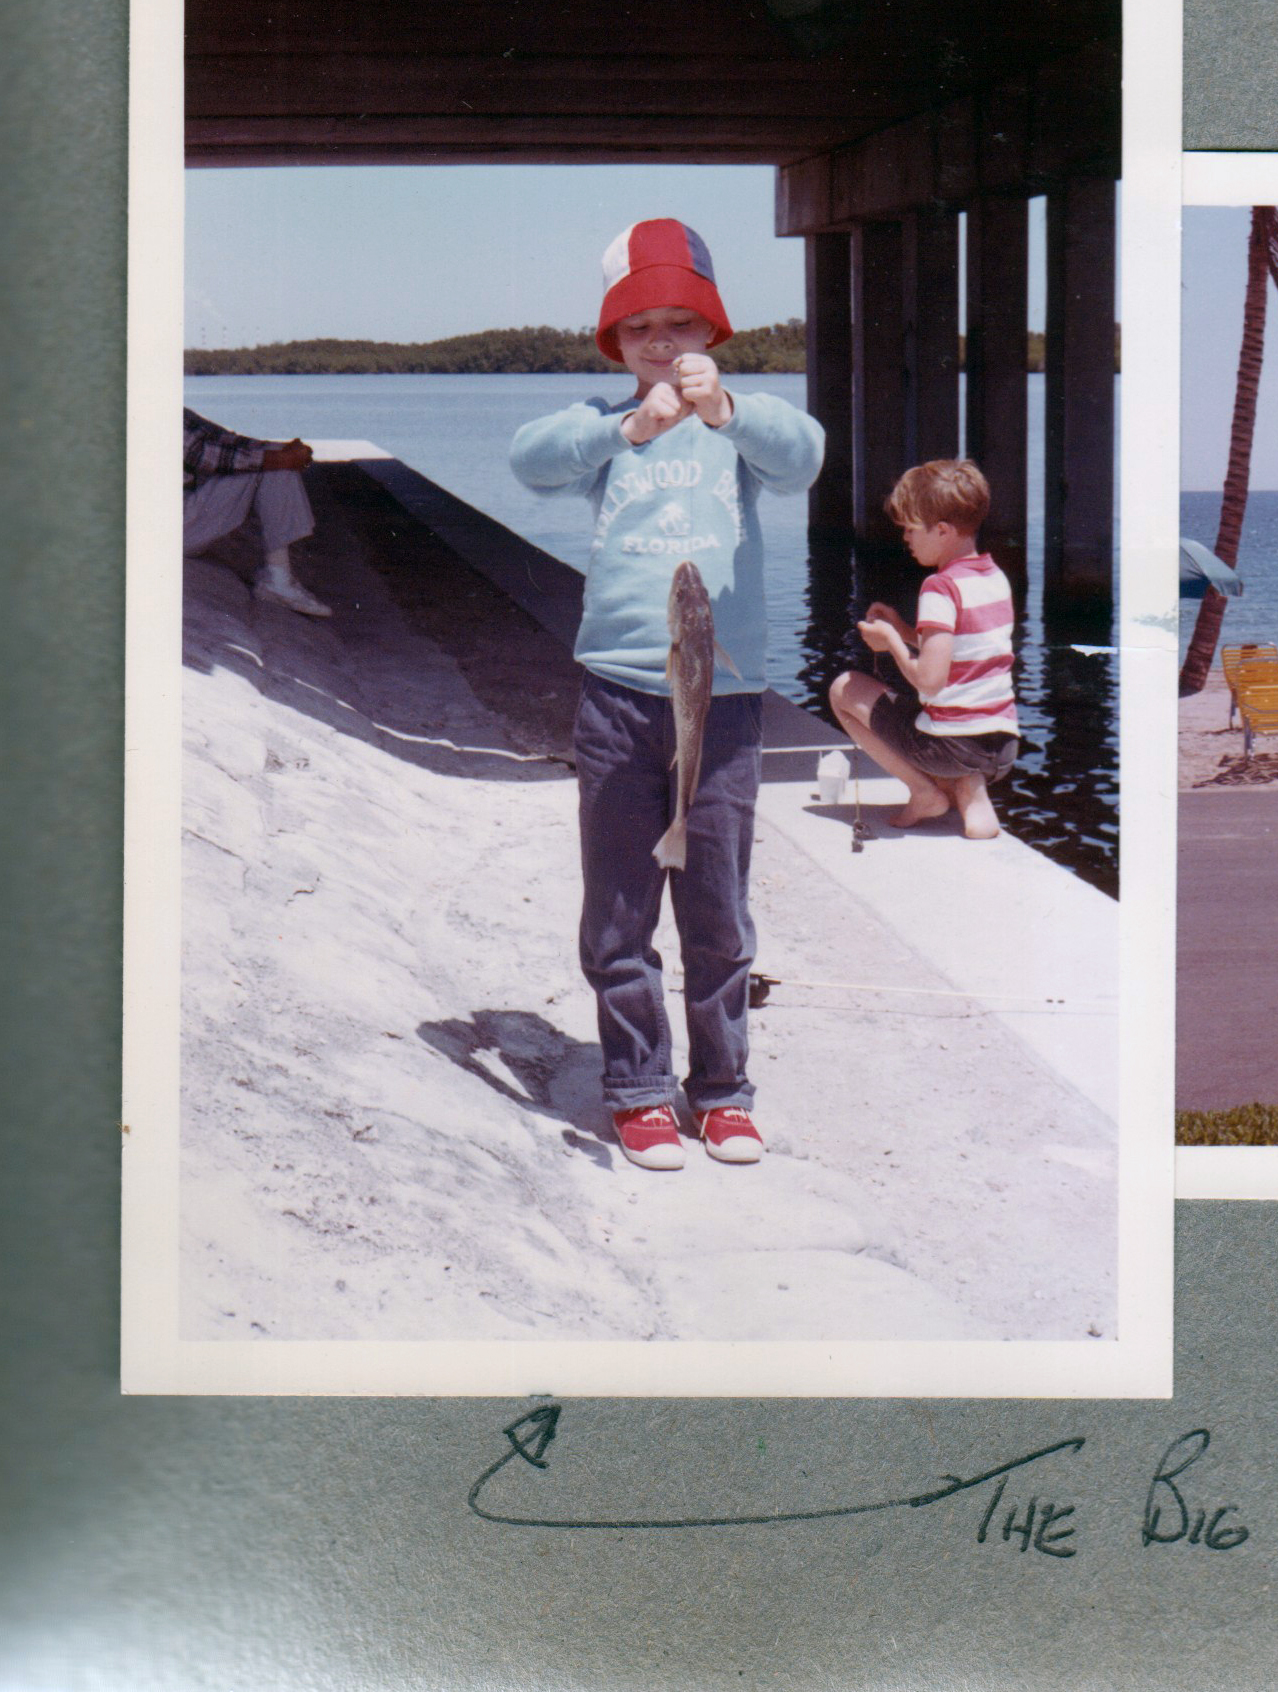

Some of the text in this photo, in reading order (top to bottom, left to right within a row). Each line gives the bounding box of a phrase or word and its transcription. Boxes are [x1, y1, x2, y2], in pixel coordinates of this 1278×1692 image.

[622, 534, 721, 554] FLORIDA
[962, 1448, 1085, 1557] THE
[1141, 1428, 1249, 1552] BIG
